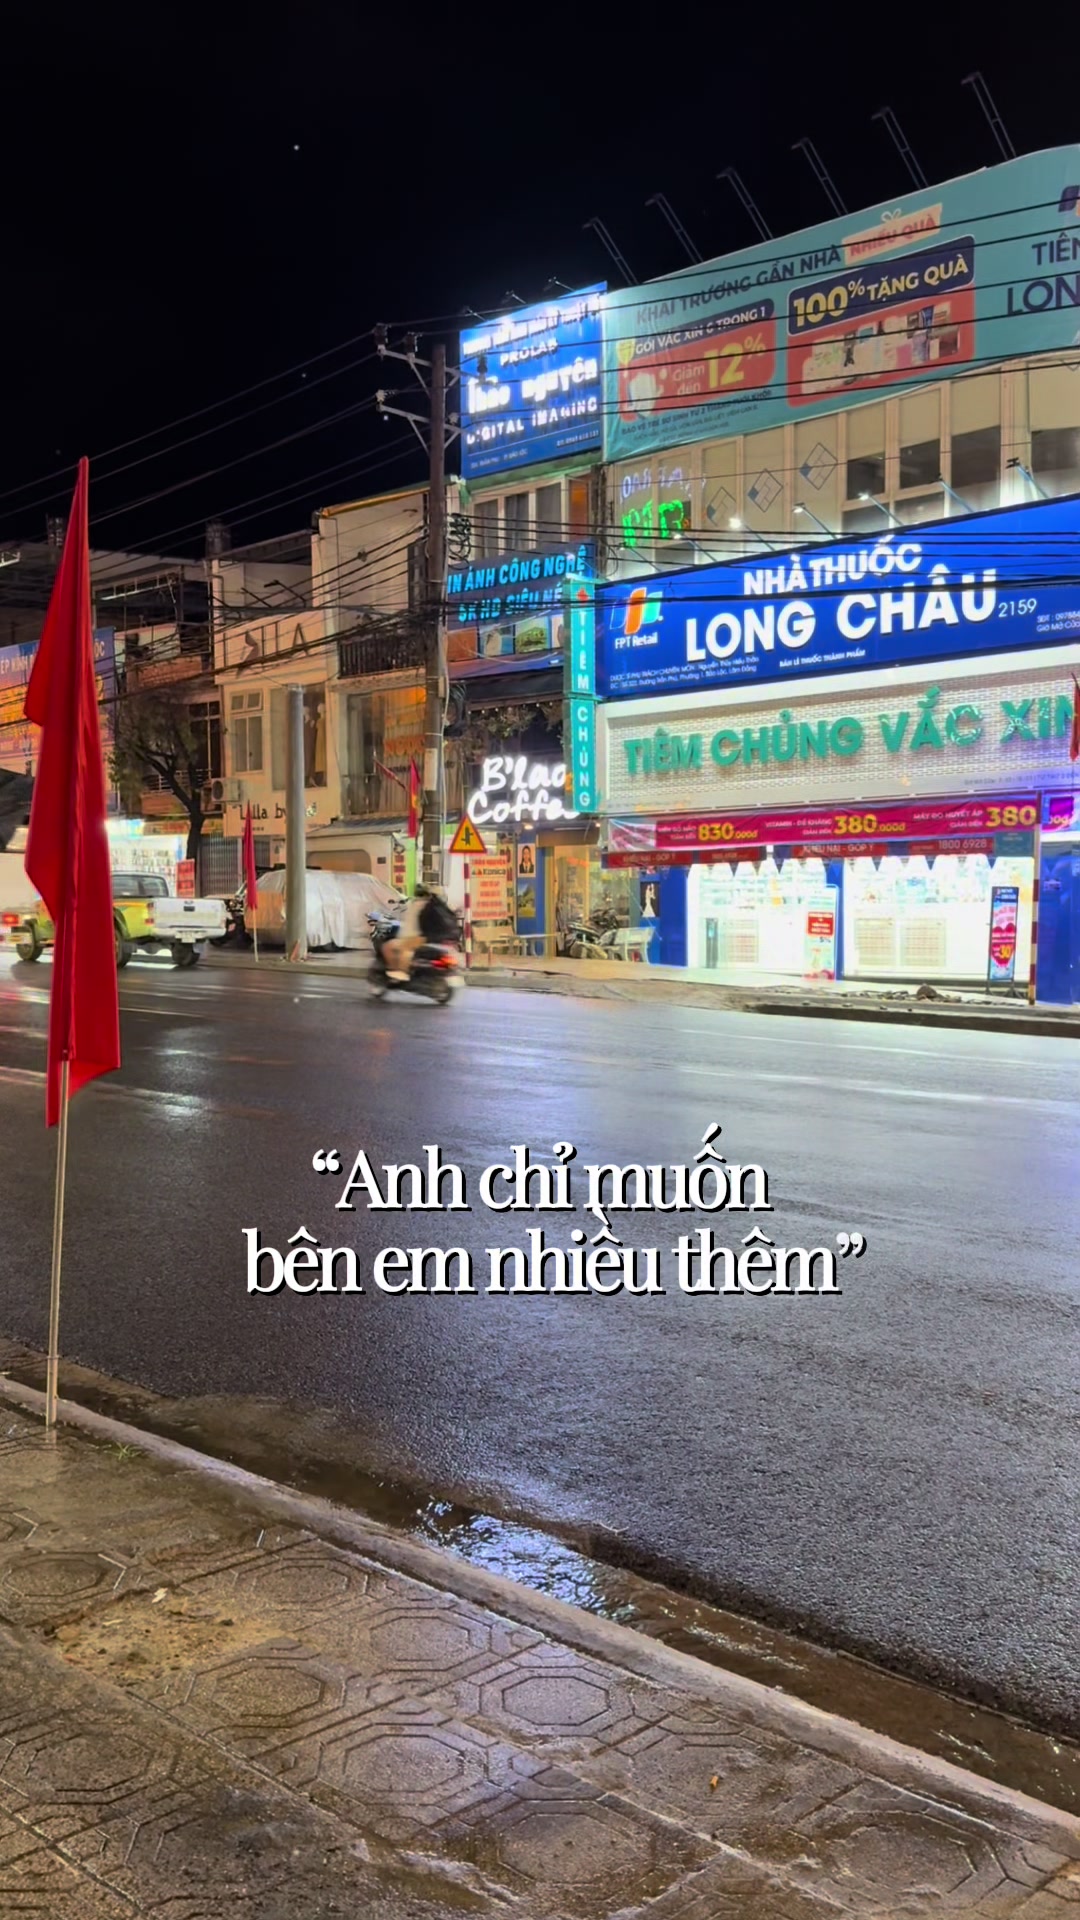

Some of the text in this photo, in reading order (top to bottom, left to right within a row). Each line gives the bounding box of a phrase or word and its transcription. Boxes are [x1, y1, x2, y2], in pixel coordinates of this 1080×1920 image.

[636, 301, 675, 325] KHAI
[756, 260, 795, 287] GẦN
[800, 245, 841, 275] NHÀ
[793, 254, 969, 328] 100% TẶNG QUÀ
[636, 337, 655, 355] GÓI
[716, 310, 758, 331] TRONG
[760, 306, 767, 318] 1
[672, 364, 706, 383] Giảm
[704, 332, 767, 389] 12%
[447, 573, 463, 594] IN
[500, 557, 541, 585] CÔNG
[744, 534, 923, 596] NHÀ THUỐC
[615, 632, 659, 649] FPT Retail
[686, 563, 1037, 662] LONG CHÂU 2159
[624, 686, 1075, 776] TIÊM CHỦNG VẮC XIN
[939, 840, 960, 849] 1800
[962, 839, 987, 849] 6928
